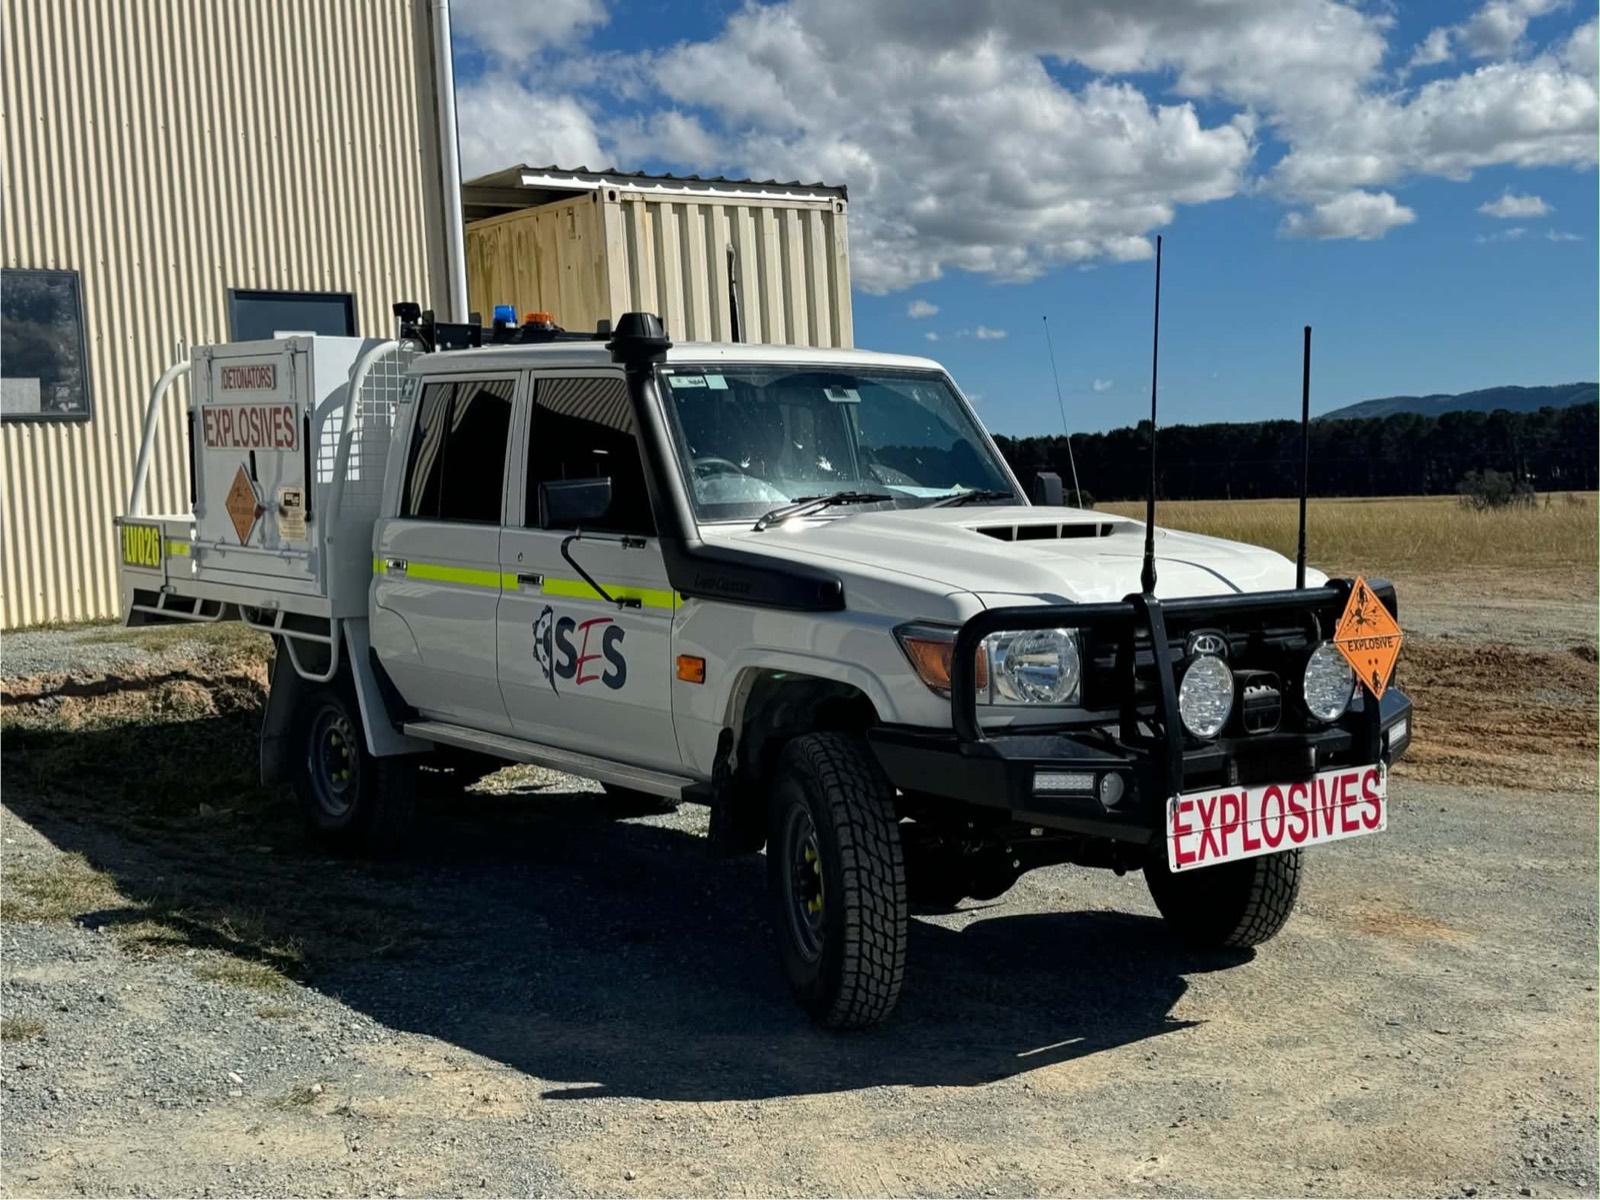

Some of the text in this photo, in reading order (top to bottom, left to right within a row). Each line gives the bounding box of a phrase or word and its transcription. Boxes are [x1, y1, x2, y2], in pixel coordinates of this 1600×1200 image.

[223, 368, 272, 389] DETONATORS
[205, 406, 294, 448] EXPLOSIVES
[554, 616, 627, 690] SES
[1347, 636, 1394, 652] EXPLOSIVE
[1173, 768, 1381, 865] EXPLOSIVES
